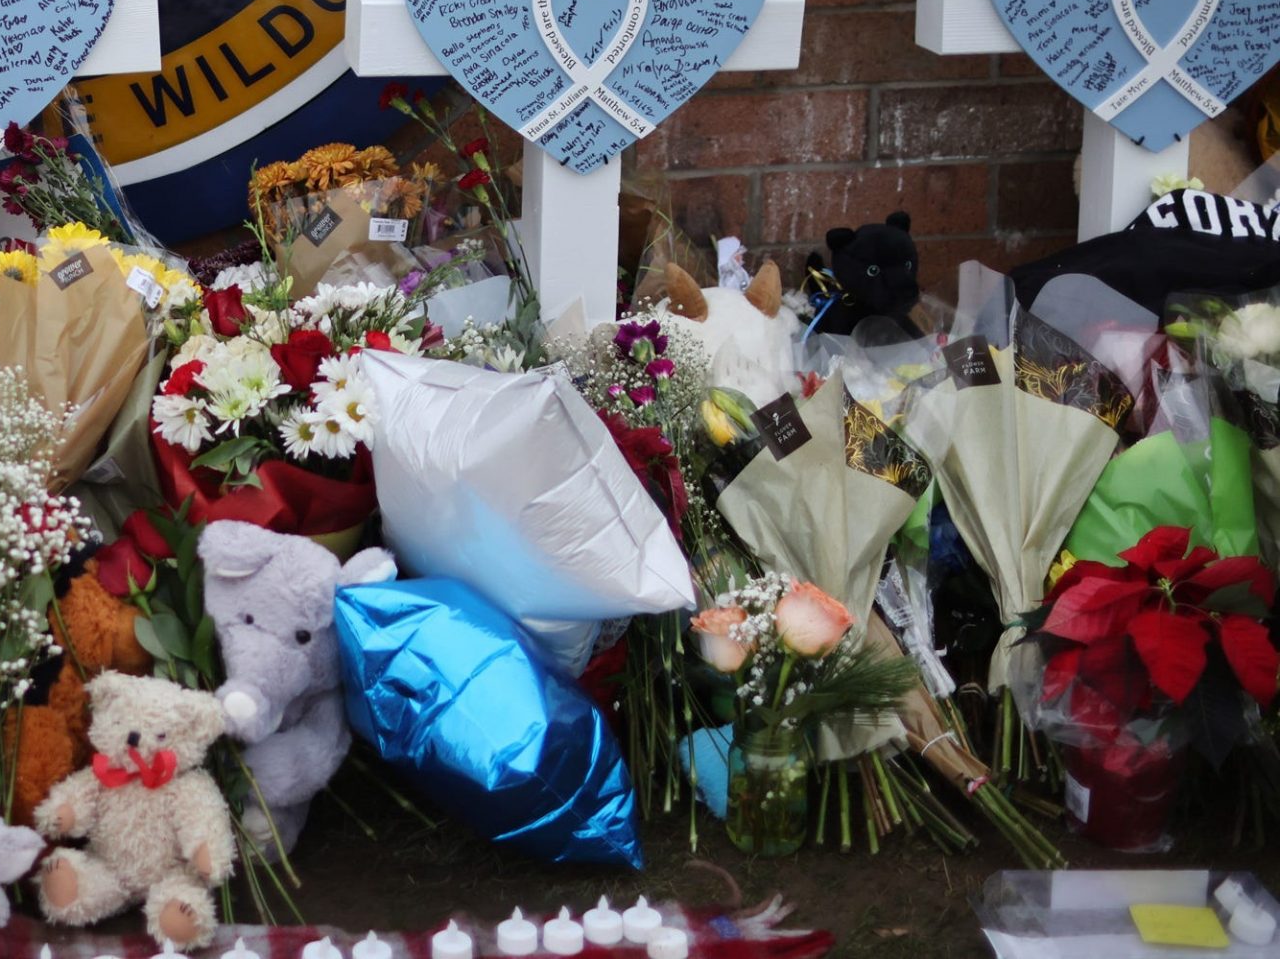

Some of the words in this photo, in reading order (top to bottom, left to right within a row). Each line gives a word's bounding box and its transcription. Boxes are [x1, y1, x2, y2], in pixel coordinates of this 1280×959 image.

[541, 11, 553, 29] are
[1120, 1, 1133, 19] are
[551, 31, 577, 71] Blessed
[603, 6, 641, 64] comforted.
[1127, 18, 1155, 56] Blessed
[1109, 95, 1130, 111] Tate
[1126, 77, 1149, 97] Myre
[1169, 68, 1206, 102] Matthew
[1202, 99, 1220, 114] 5:4
[527, 118, 550, 138] Hana
[548, 109, 561, 121] St.
[559, 85, 589, 111] Juliana
[593, 87, 632, 121] Matthew
[629, 118, 647, 134] 5:4
[963, 366, 986, 376] FARM
[777, 428, 799, 444] FARM
